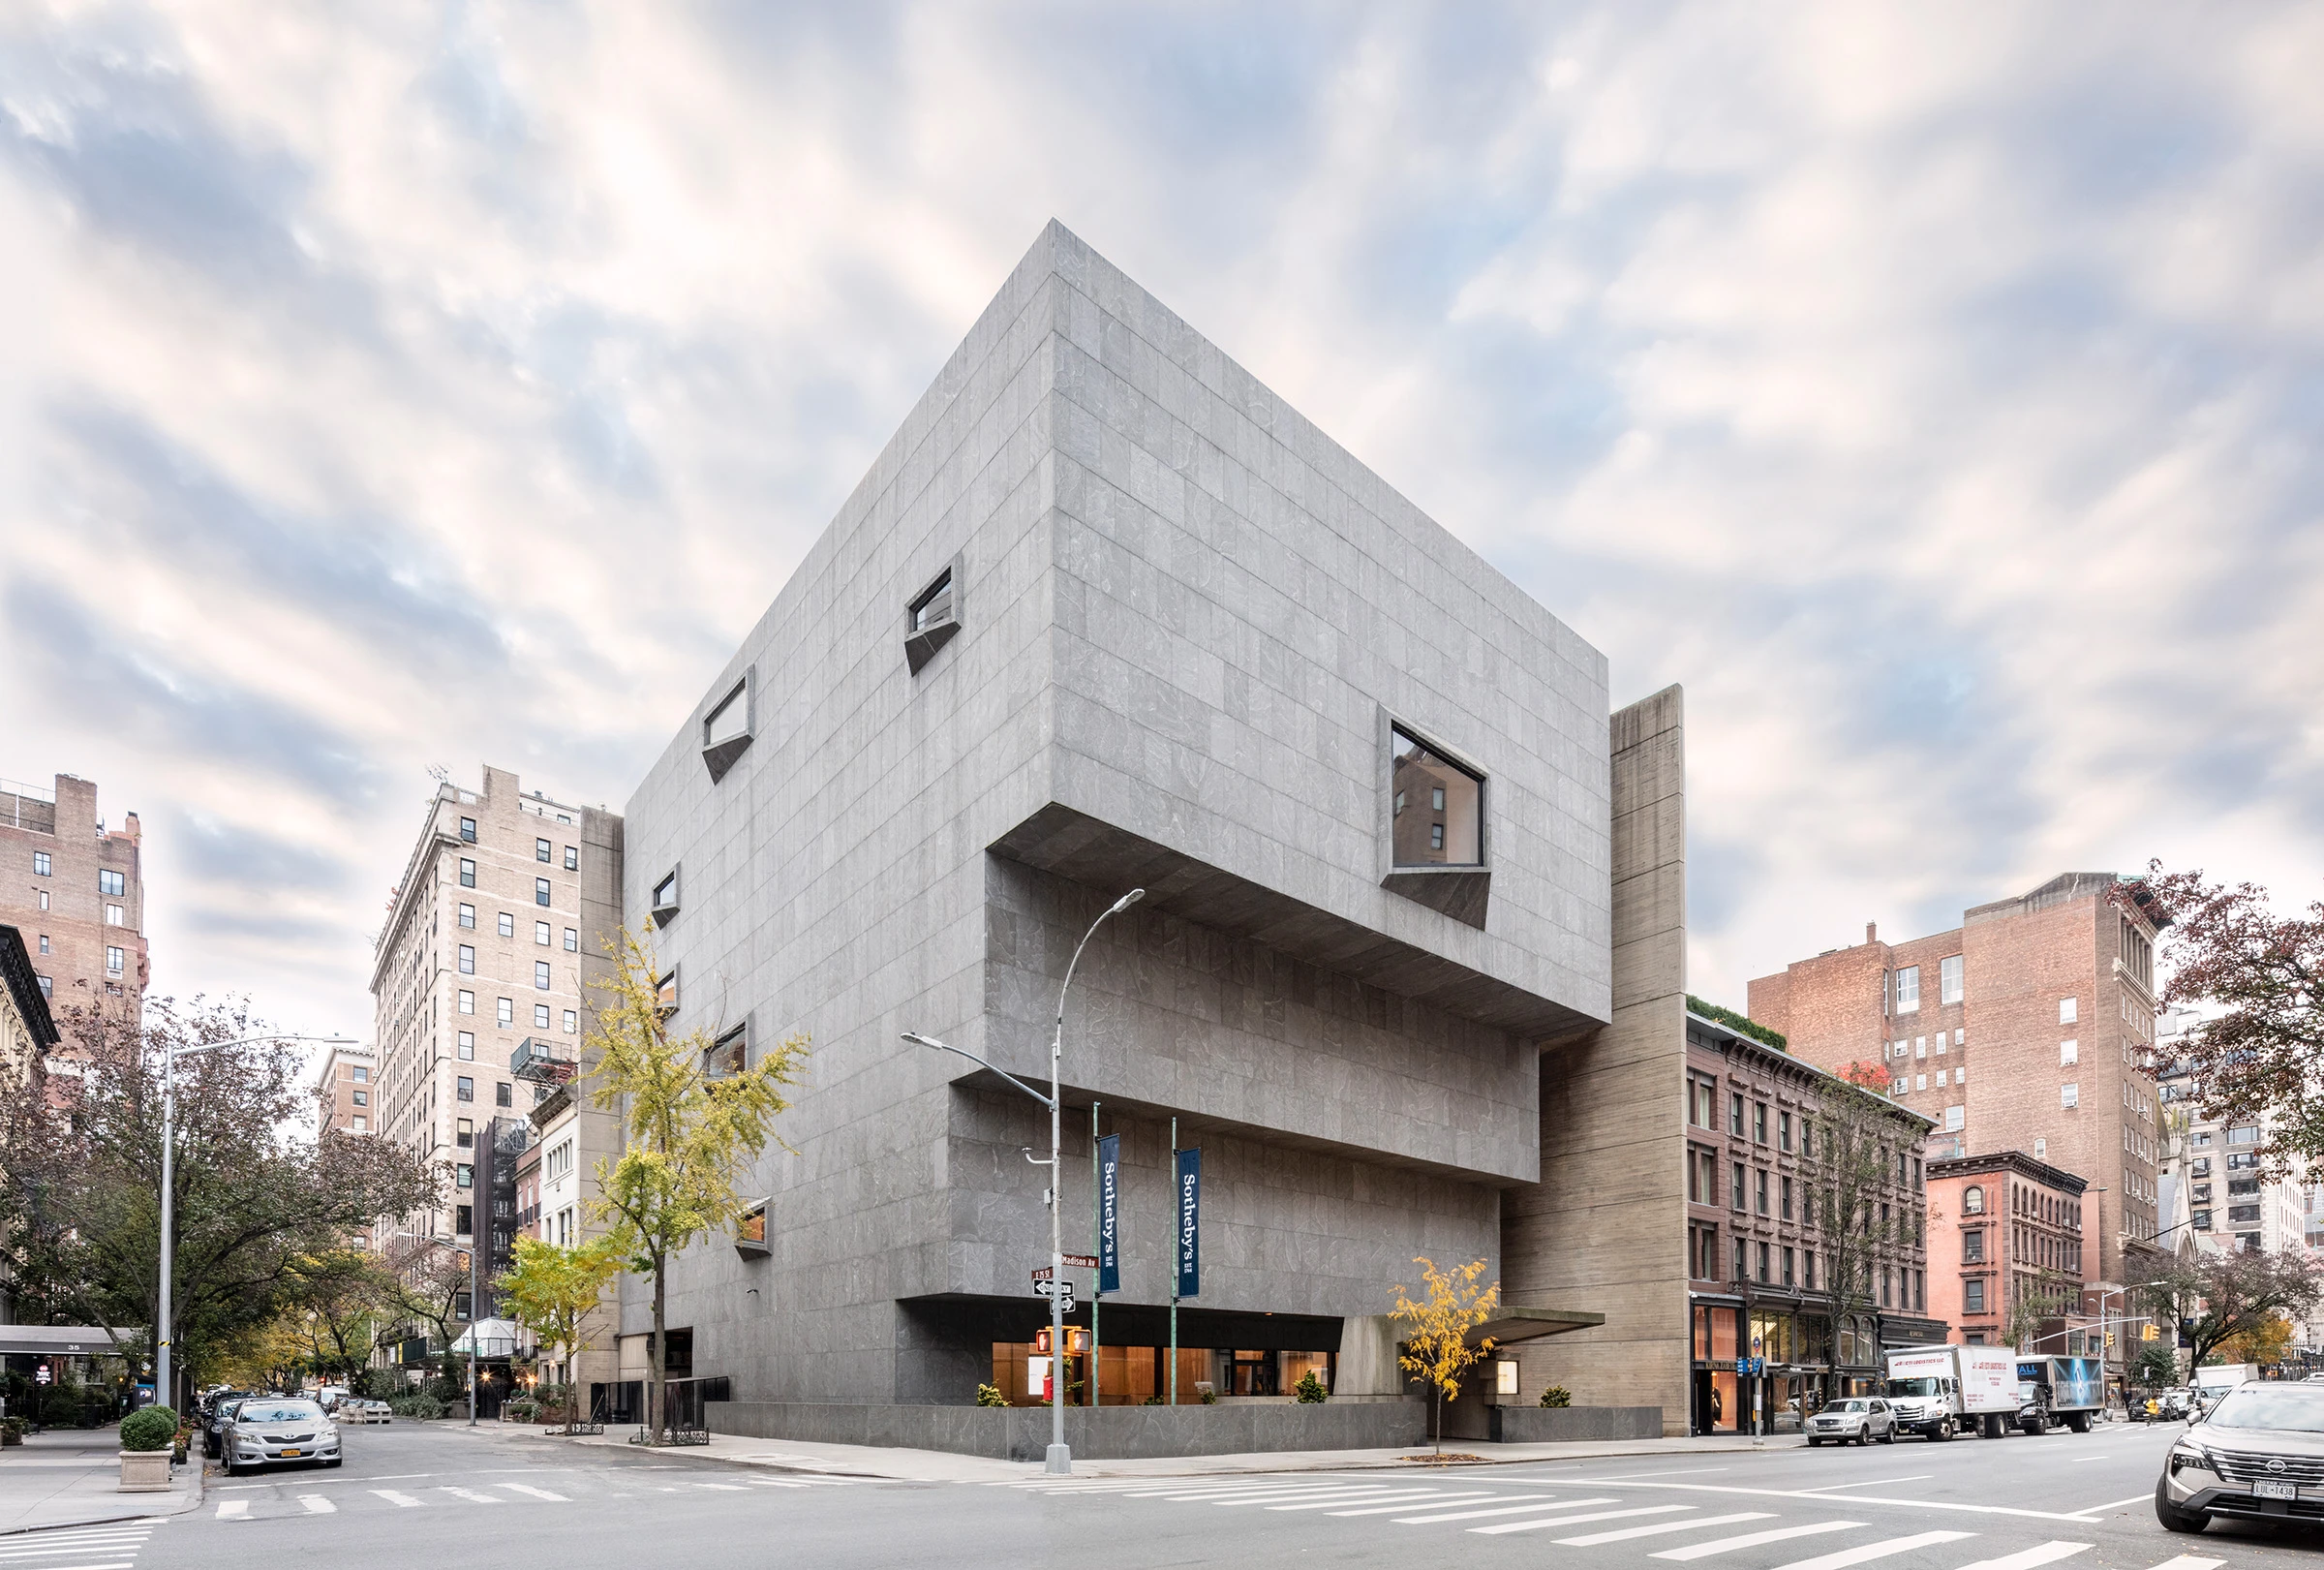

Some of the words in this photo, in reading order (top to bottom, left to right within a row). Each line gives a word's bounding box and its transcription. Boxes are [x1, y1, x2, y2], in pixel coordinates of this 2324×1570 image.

[1103, 1162, 1116, 1253] Sotheby's
[1181, 1174, 1196, 1260] Sotheby's
[1040, 1270, 1045, 1279] 75
[1045, 1269, 1050, 1278] St
[1062, 1256, 1086, 1266] Madison
